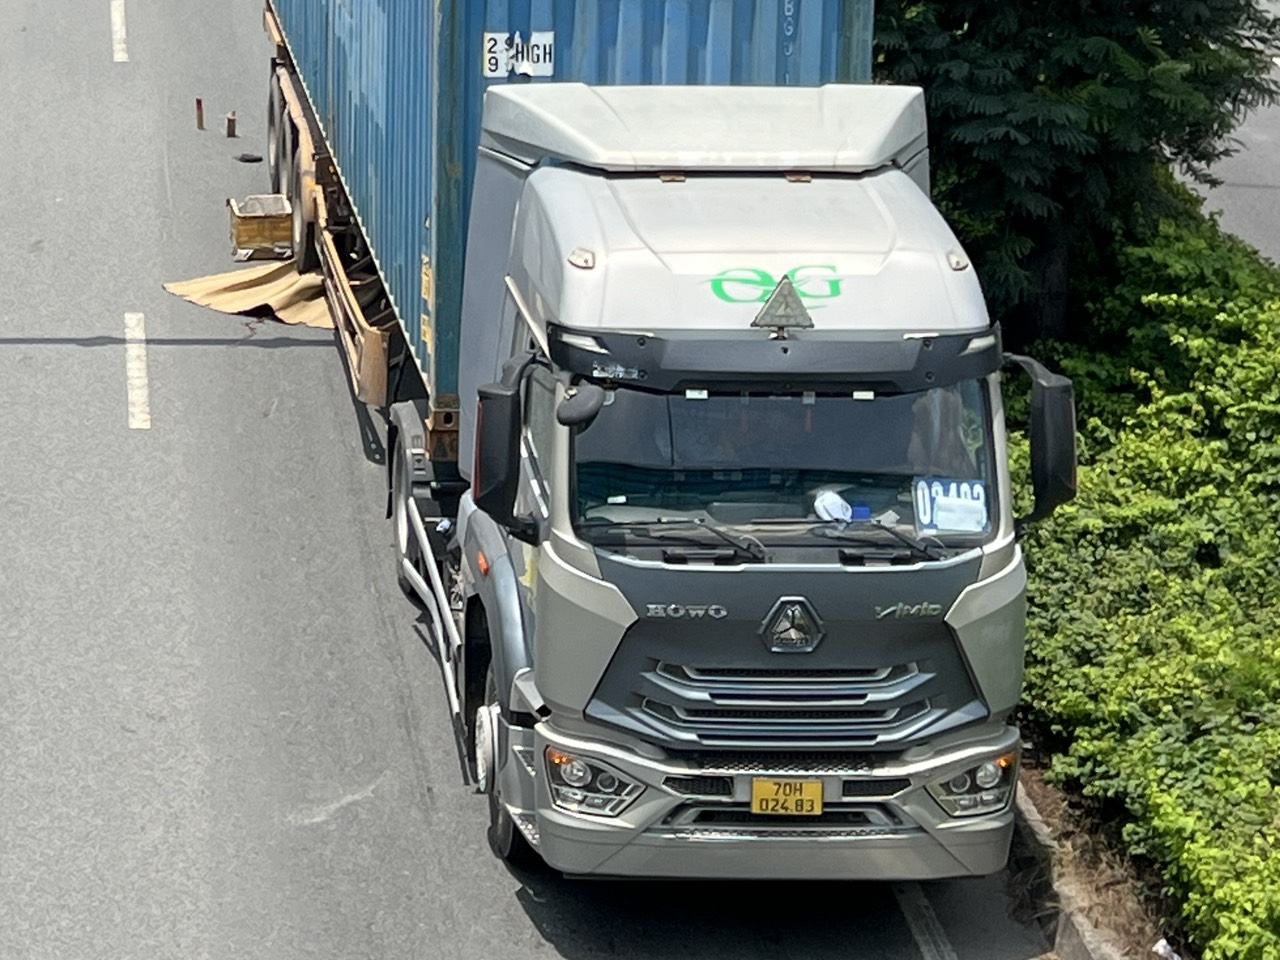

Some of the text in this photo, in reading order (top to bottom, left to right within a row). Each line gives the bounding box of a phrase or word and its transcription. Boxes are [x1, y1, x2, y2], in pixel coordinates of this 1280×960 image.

[515, 43, 553, 64] HIGH
[646, 603, 728, 619] HOWO
[773, 782, 803, 796] 70H
[759, 798, 815, 812] 024.83
